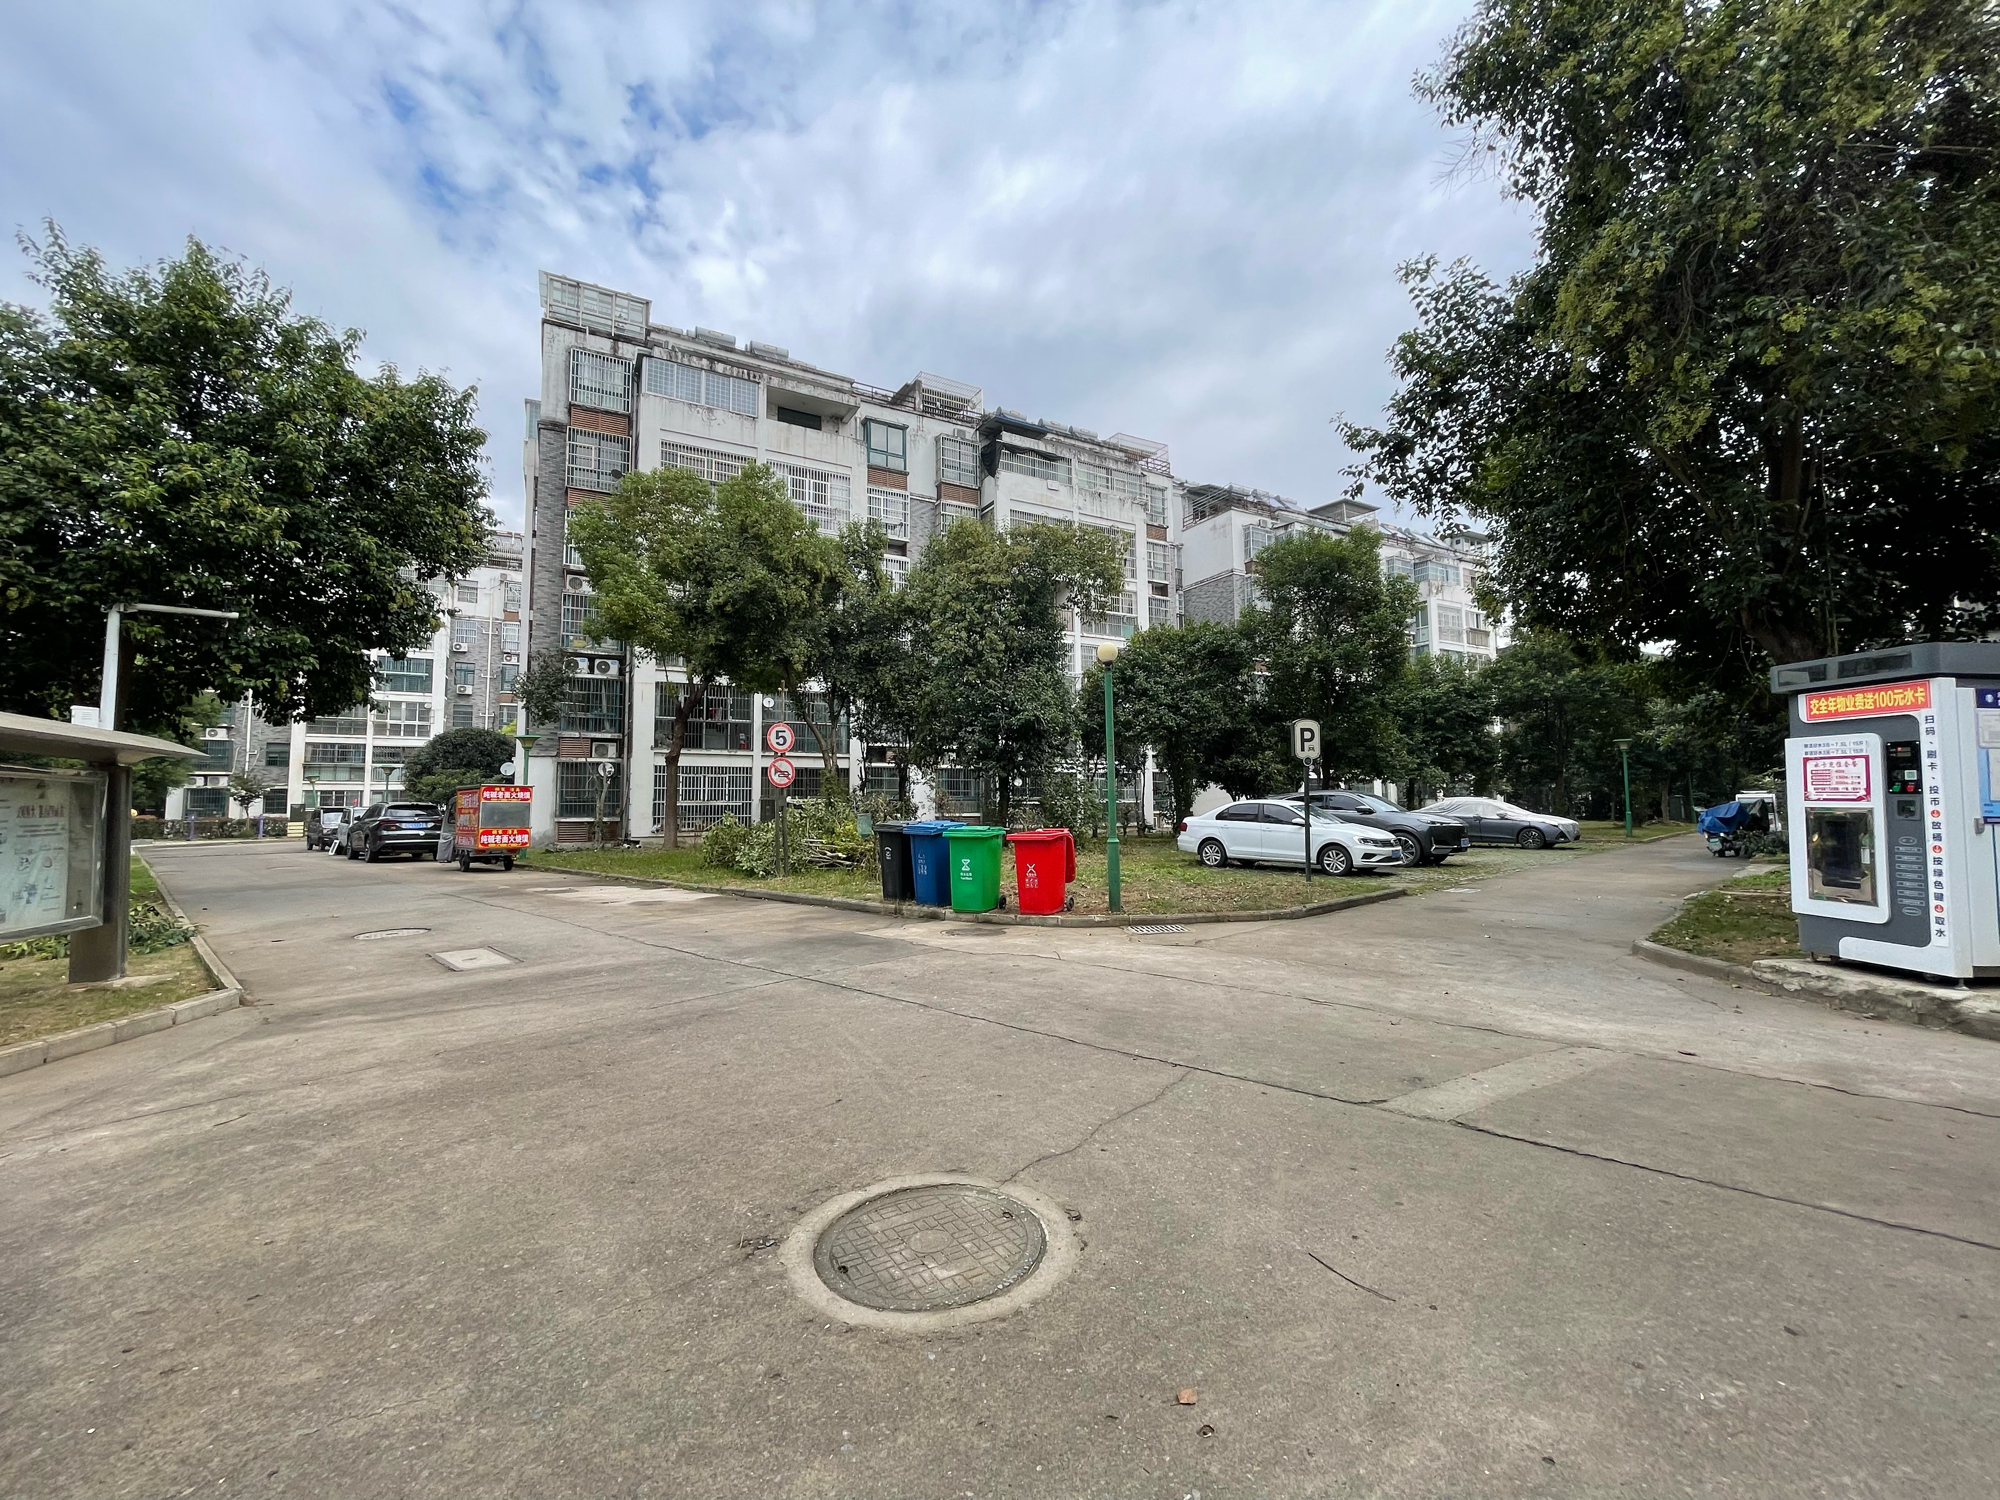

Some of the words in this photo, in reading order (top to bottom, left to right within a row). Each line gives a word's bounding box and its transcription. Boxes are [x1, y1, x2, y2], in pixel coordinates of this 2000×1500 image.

[1810, 686, 1926, 715] 交全年物业费送100元水卡
[775, 730, 787, 746] 5
[1300, 727, 1315, 752] P
